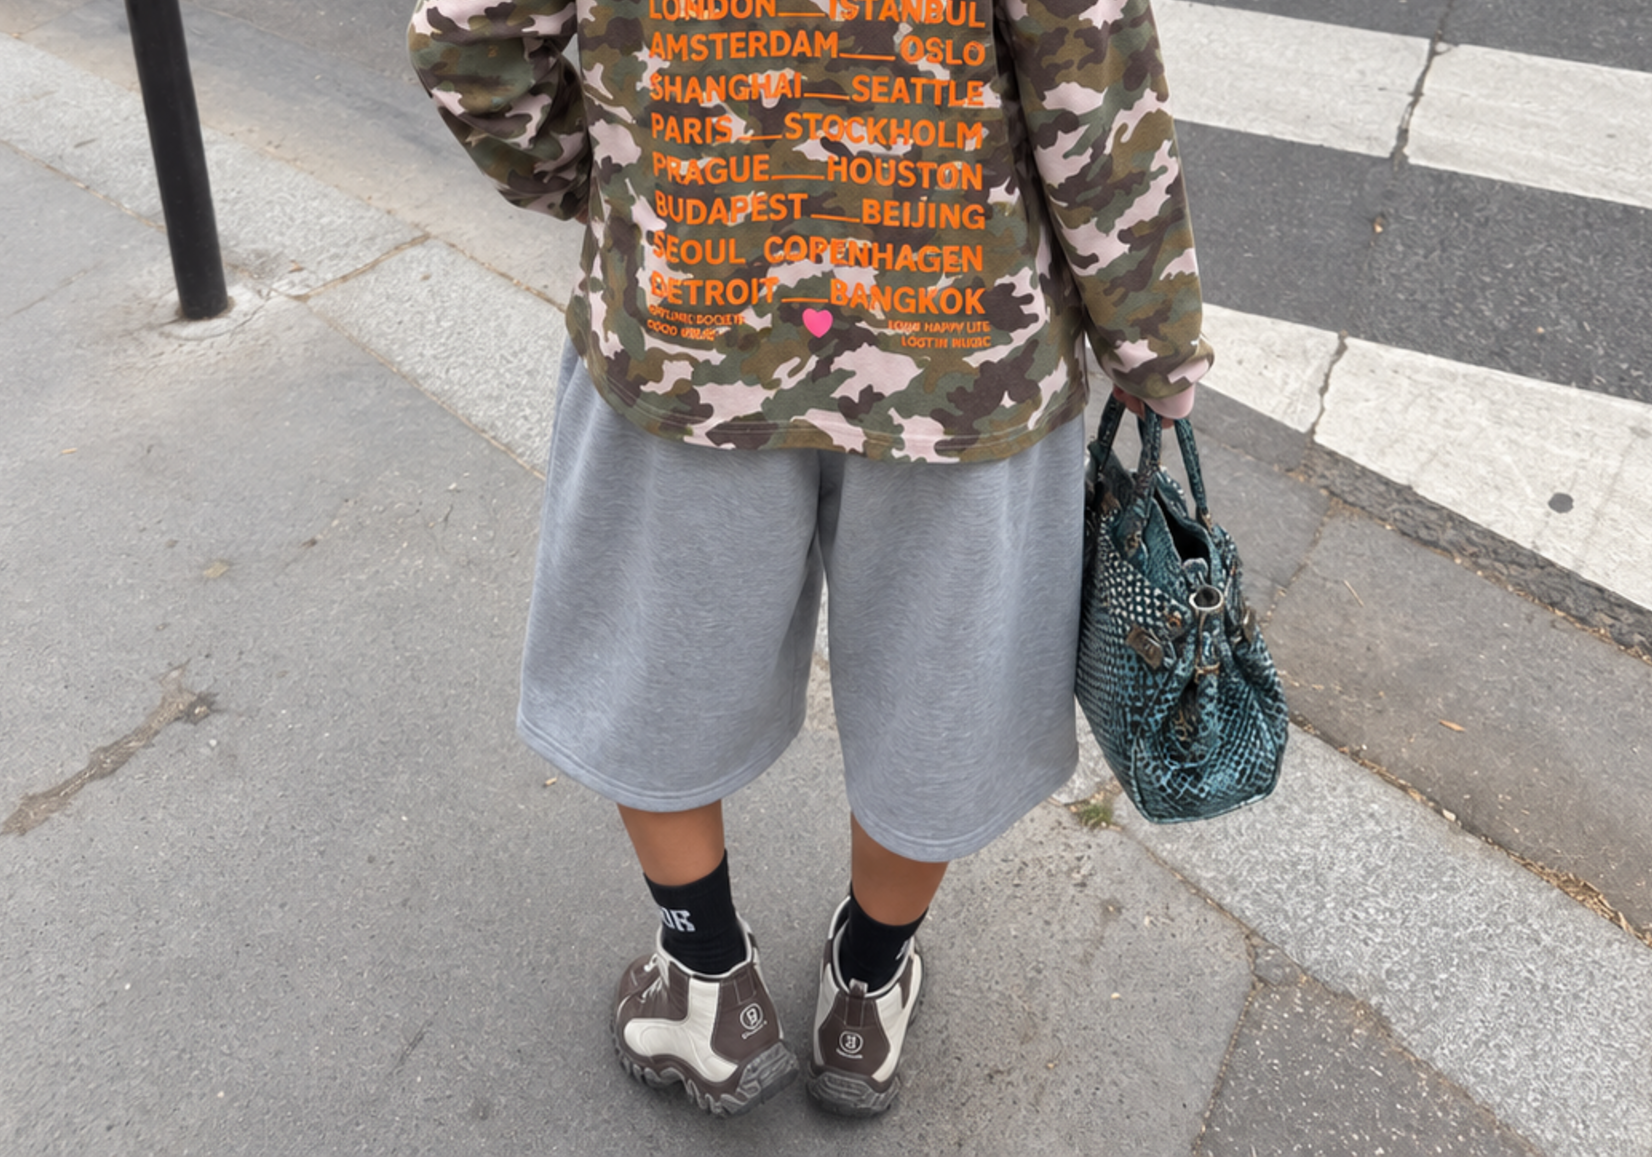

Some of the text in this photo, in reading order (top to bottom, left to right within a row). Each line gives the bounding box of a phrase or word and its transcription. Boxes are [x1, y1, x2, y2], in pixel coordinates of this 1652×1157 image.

[649, 30, 986, 66] AMSTERDAM OSLO
[649, 72, 985, 108] SHANGHAI SEATTLE
[650, 112, 985, 150] PARIS STOCKHOLM
[652, 151, 984, 191] PRAGUE HOUSTON
[654, 189, 986, 230] BUDAPEST BEIJING
[651, 230, 983, 274] SEOUL COPENHAGEN
[649, 271, 988, 315] DETROIT BANGKOK
